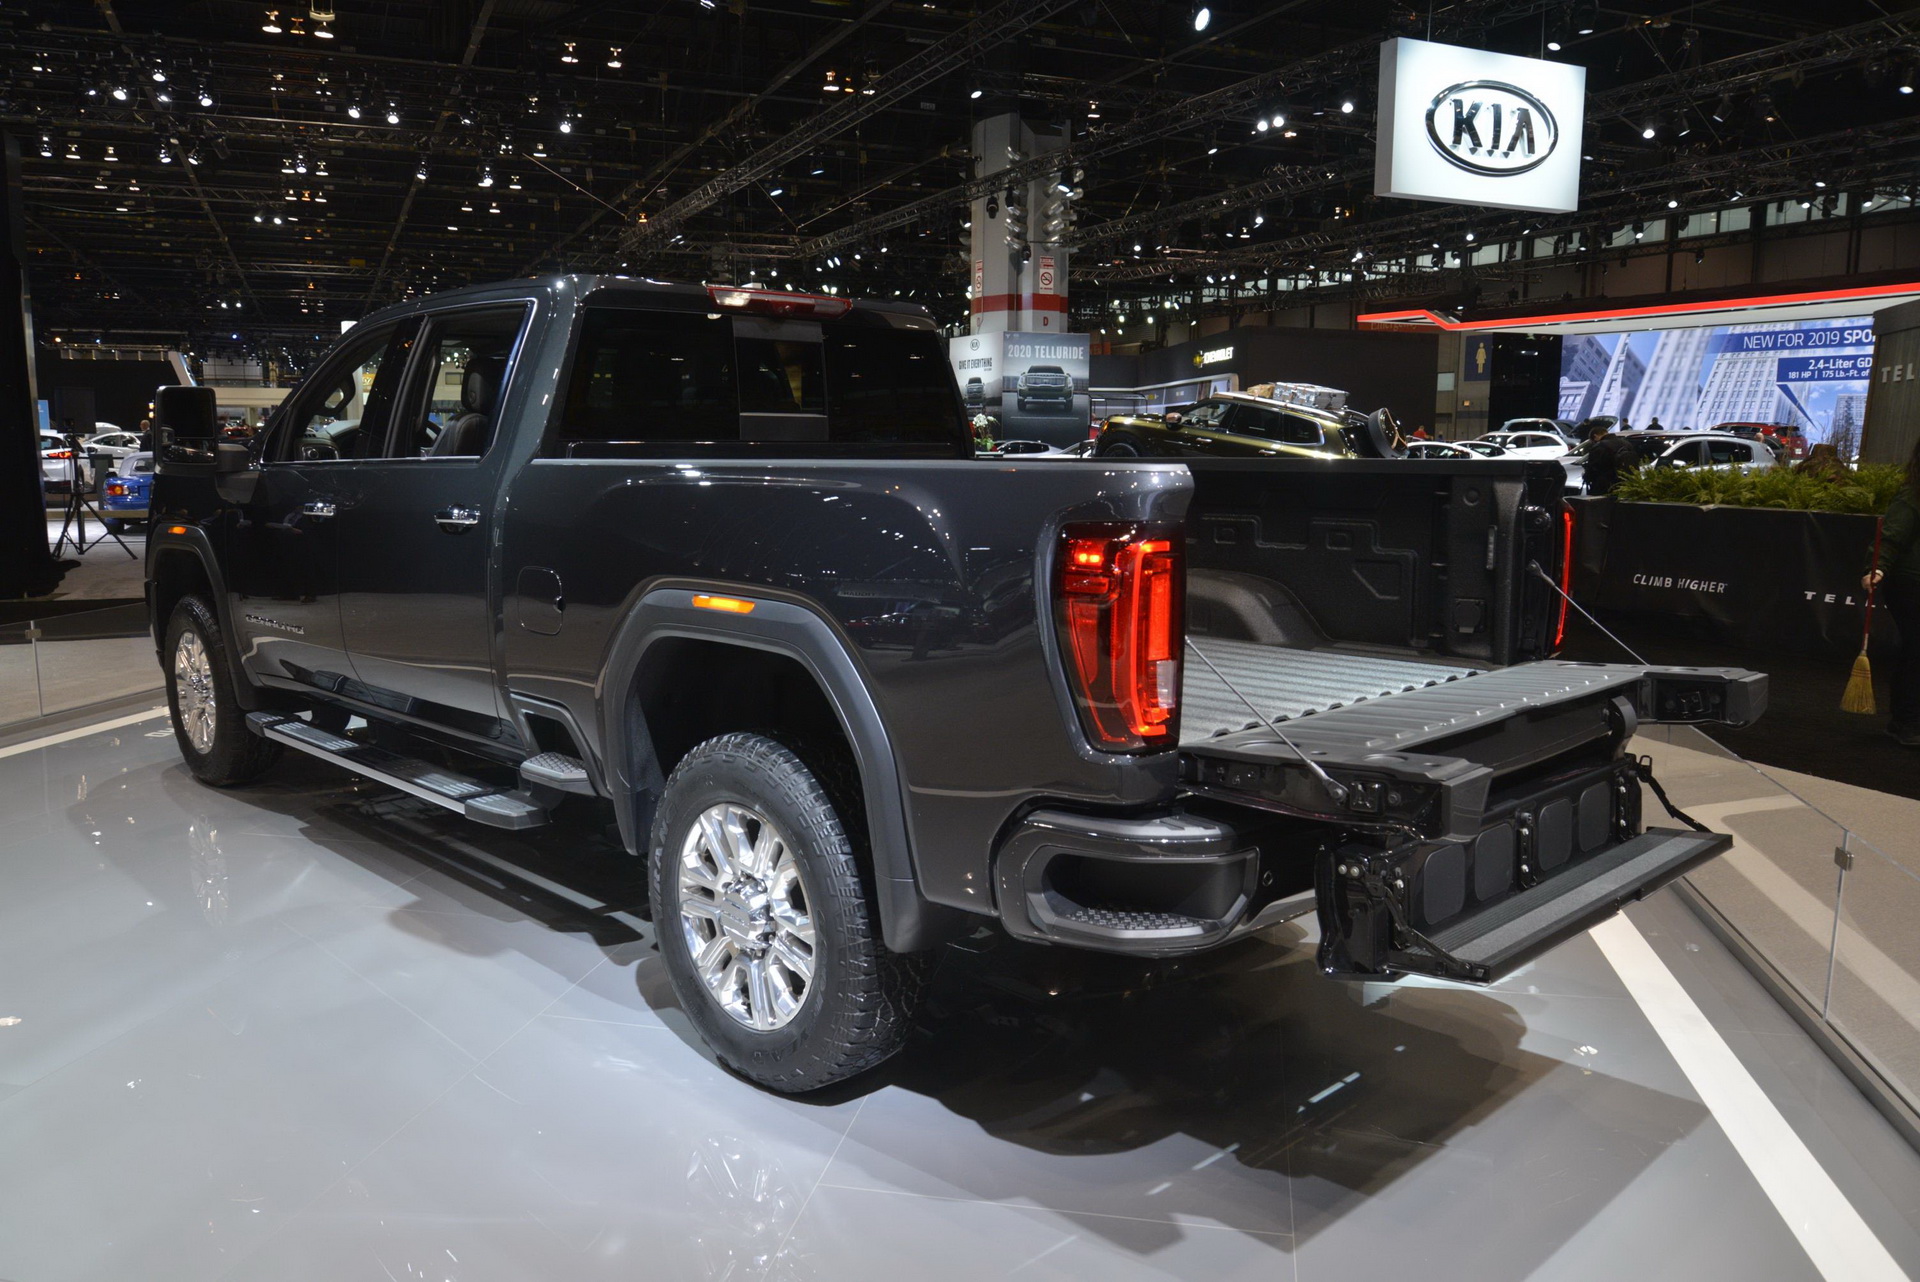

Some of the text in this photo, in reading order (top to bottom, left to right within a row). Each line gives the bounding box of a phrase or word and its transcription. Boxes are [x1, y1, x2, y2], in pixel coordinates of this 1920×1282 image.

[1450, 98, 1535, 155] KIA
[1043, 316, 1049, 326] D
[1744, 335, 1774, 349] NEW
[1777, 333, 1804, 347] FOR
[1808, 331, 1840, 345] 2019
[1008, 344, 1032, 358] 2020
[1034, 345, 1084, 360] TELLURIDE
[1808, 359, 1854, 370] 2.4-Liter
[1788, 371, 1799, 379] 181
[1801, 371, 1812, 379] HP
[1822, 369, 1834, 378] 175
[1861, 369, 1870, 377] of
[1881, 363, 1920, 384] TEL
[1633, 573, 1673, 588] CLIMB
[1804, 591, 1888, 609] TEL
